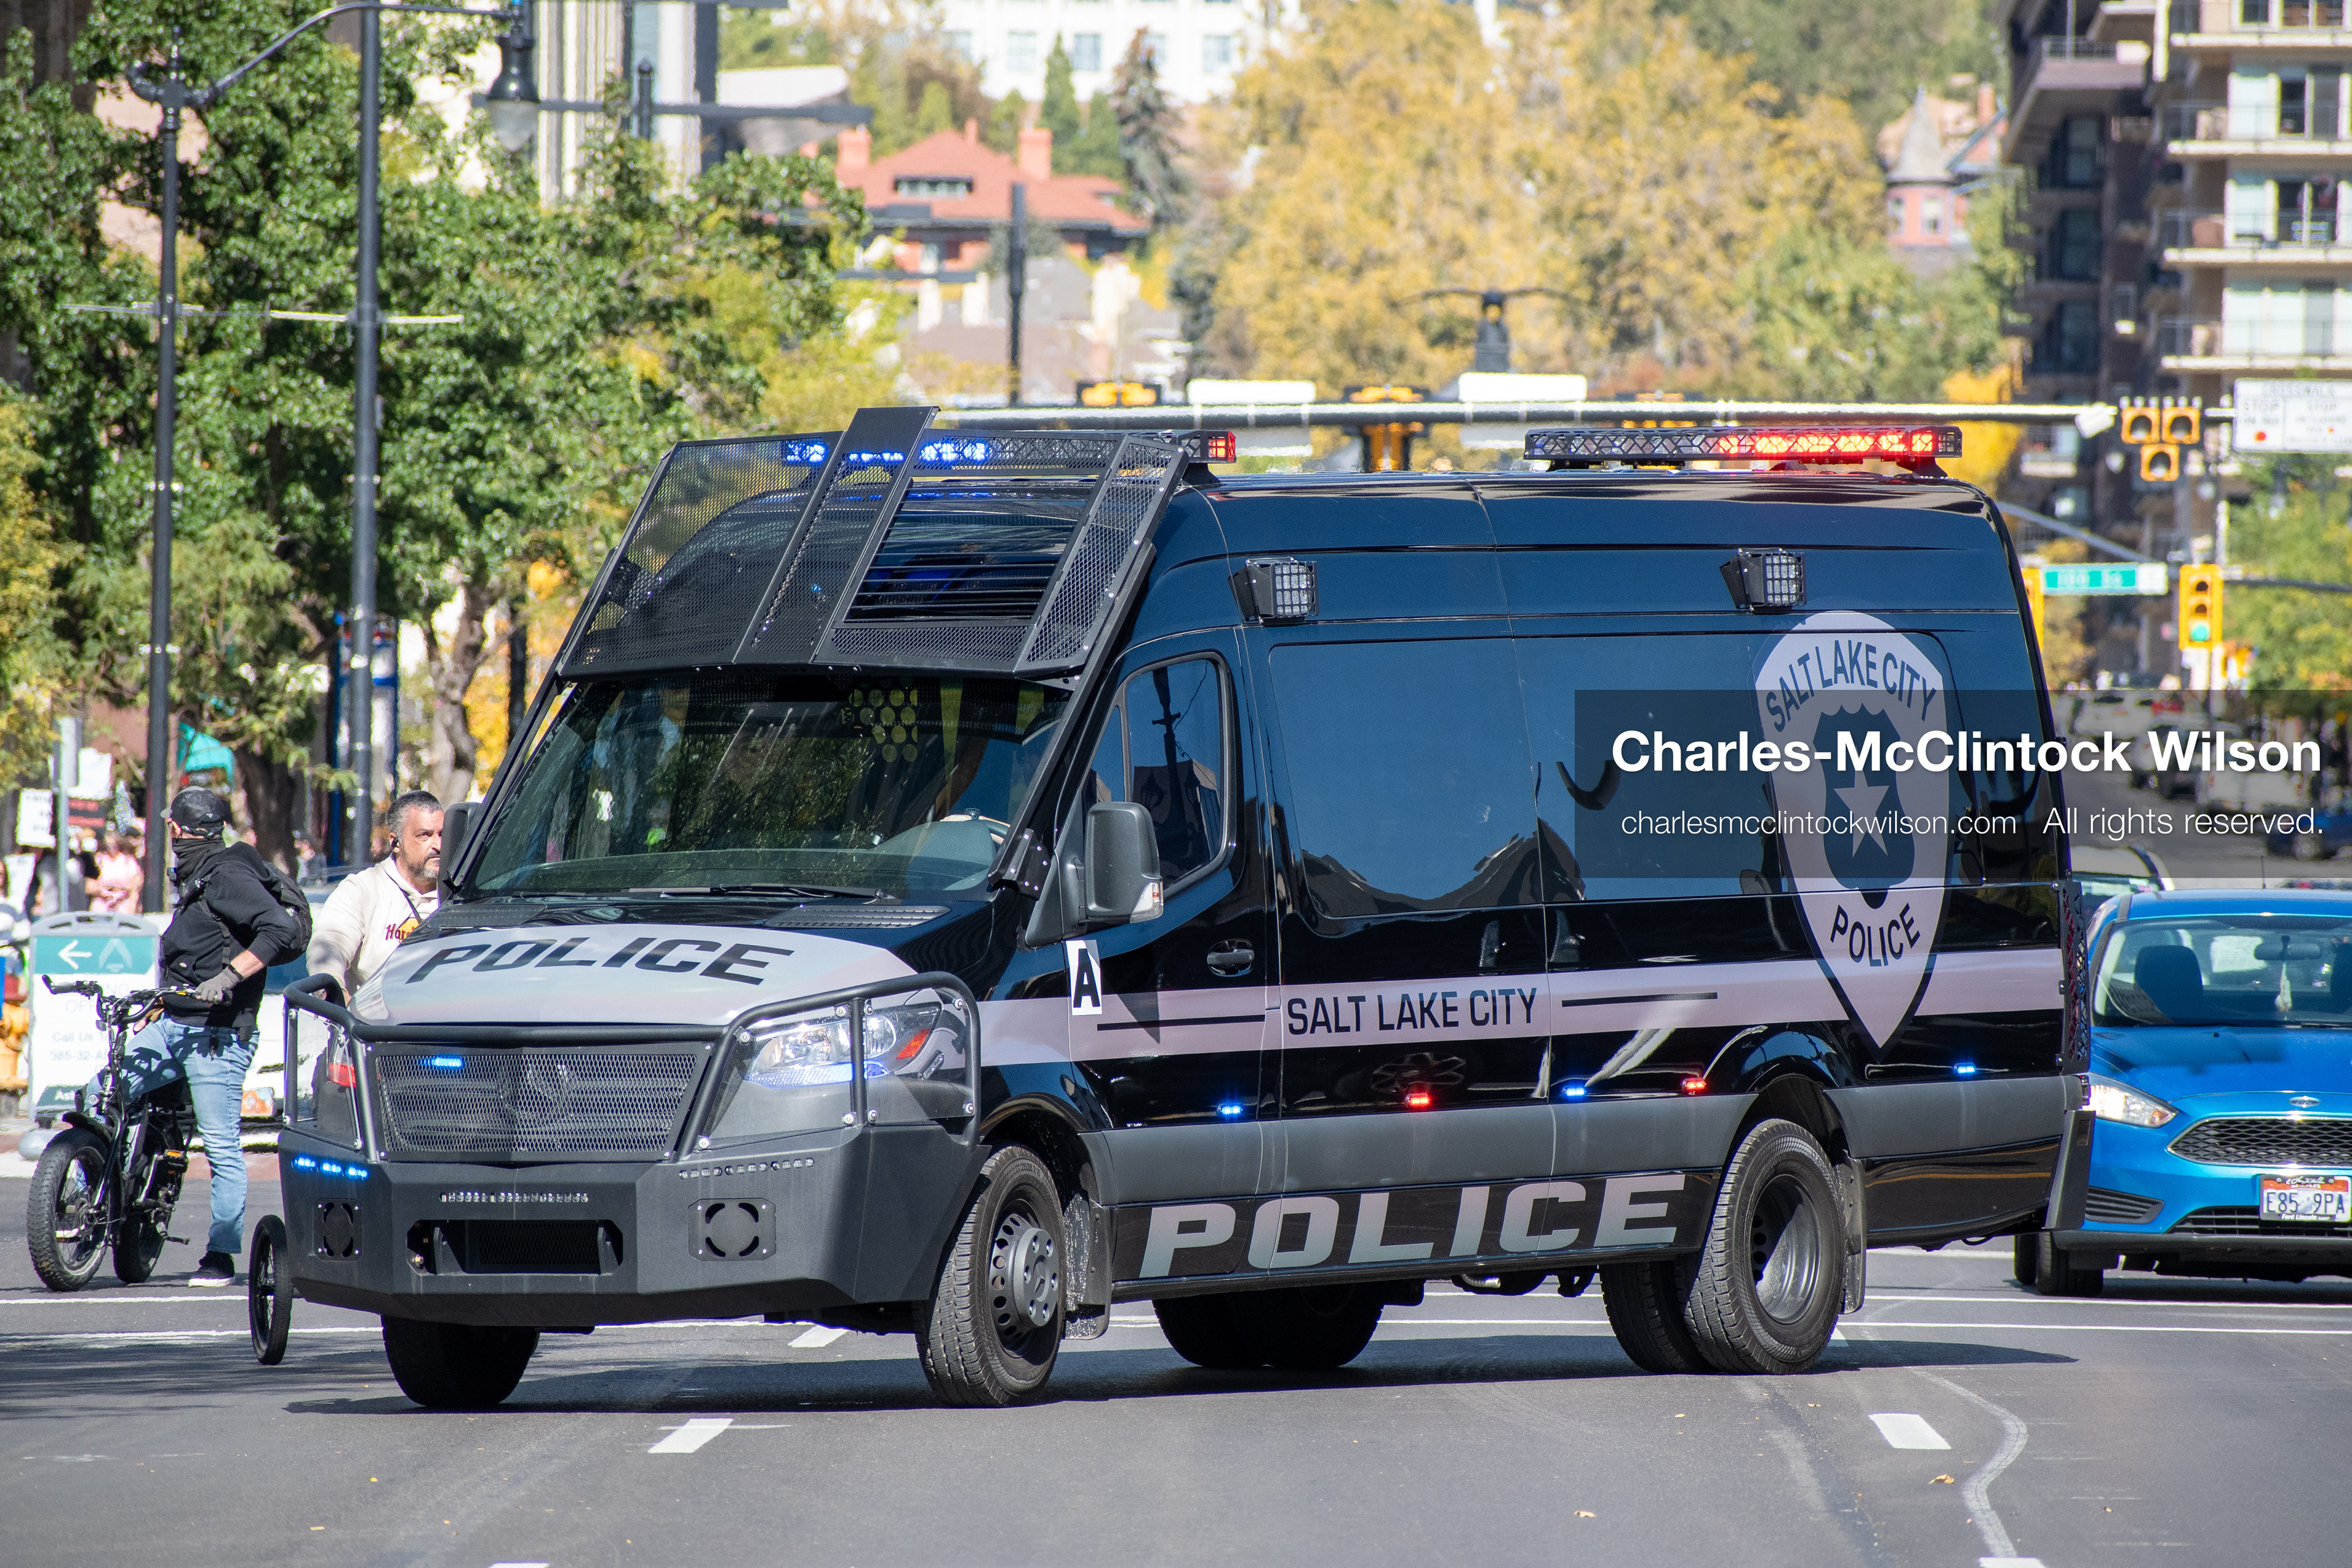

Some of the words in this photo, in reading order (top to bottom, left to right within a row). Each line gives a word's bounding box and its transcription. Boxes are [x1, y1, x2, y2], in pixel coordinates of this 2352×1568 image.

[2242, 399, 2279, 413] STOP
[1766, 652, 1815, 733] SALT
[1815, 639, 1878, 688] LAKE
[1882, 652, 1937, 723] CITY
[1830, 902, 1921, 967] POLICE
[404, 937, 795, 986] POLICE
[1073, 948, 1101, 1008] A
[1287, 995, 1366, 1036] SALT
[1377, 990, 1460, 1031] LAKE
[1470, 987, 1537, 1027] CITY
[52, 1031, 74, 1042] Call
[78, 1032, 94, 1041] Us
[1138, 1174, 1686, 1279] POLICE
[2267, 1191, 2298, 1213] E85
[2313, 1193, 2345, 1213] 9PA
